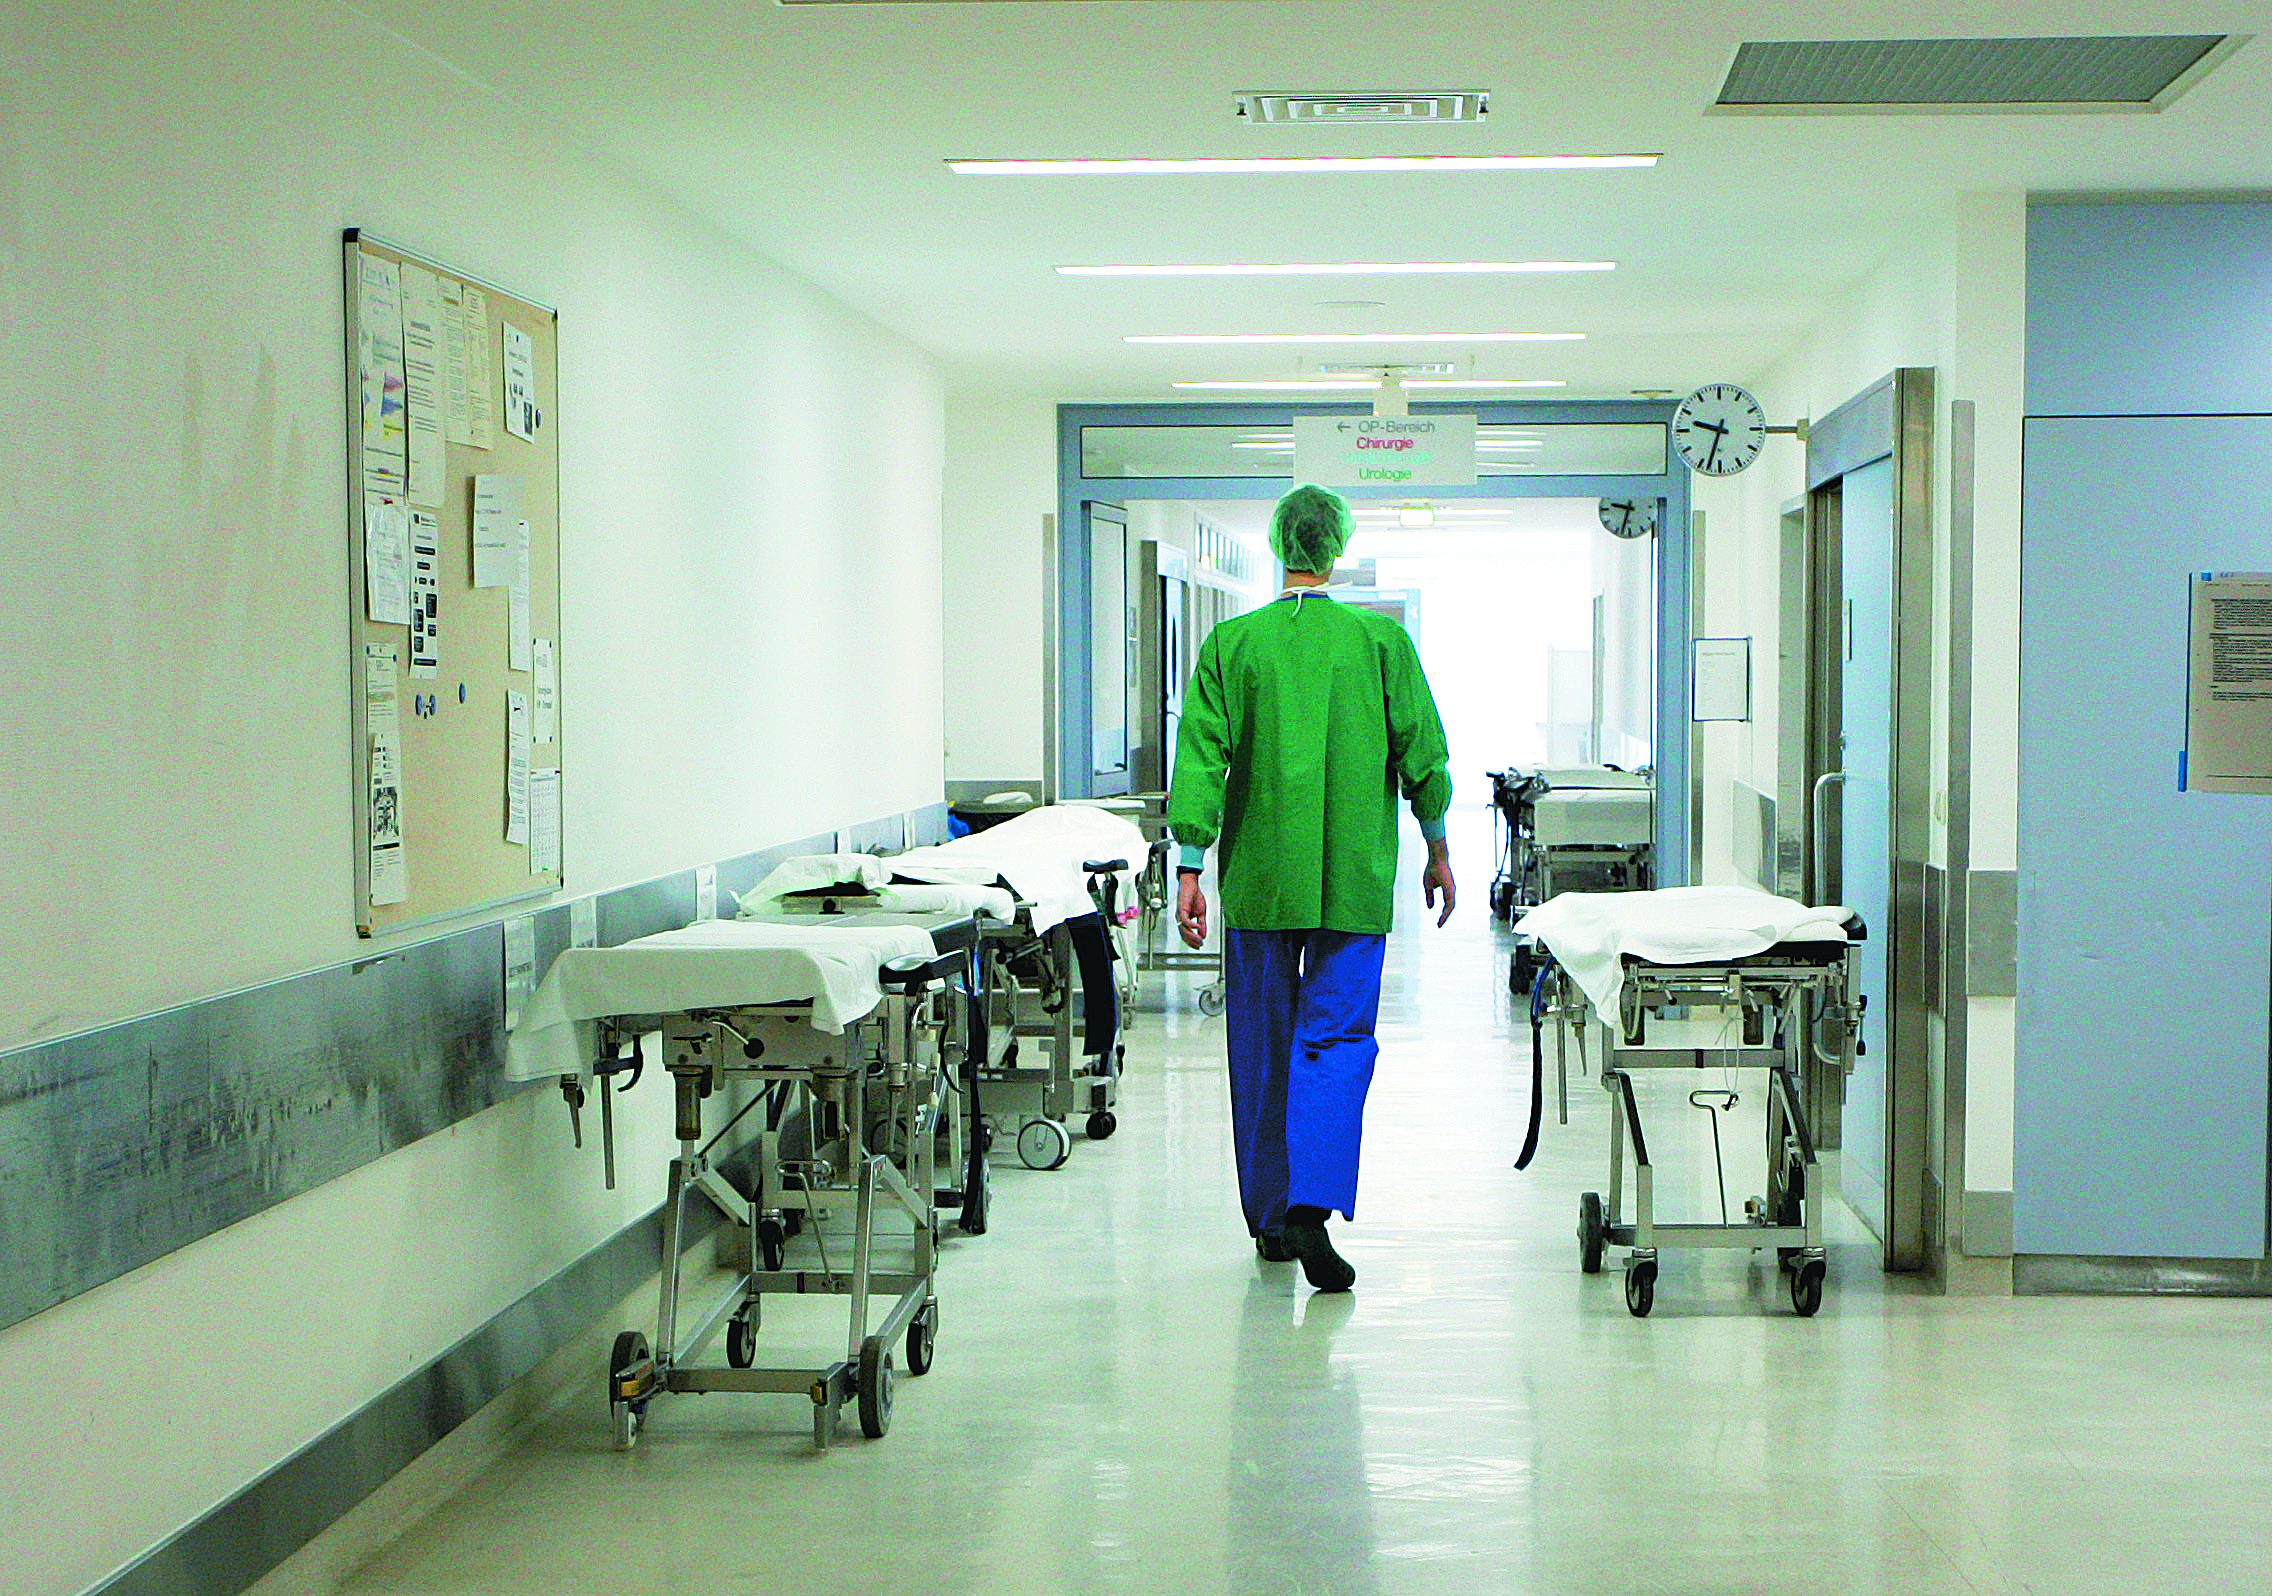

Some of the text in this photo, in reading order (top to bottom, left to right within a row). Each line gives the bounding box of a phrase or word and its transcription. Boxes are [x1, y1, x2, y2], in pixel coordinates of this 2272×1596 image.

[1358, 420, 1435, 433] OP-Bereich
[1356, 437, 1413, 451] Chirurgie
[1359, 468, 1411, 480] Urologie
